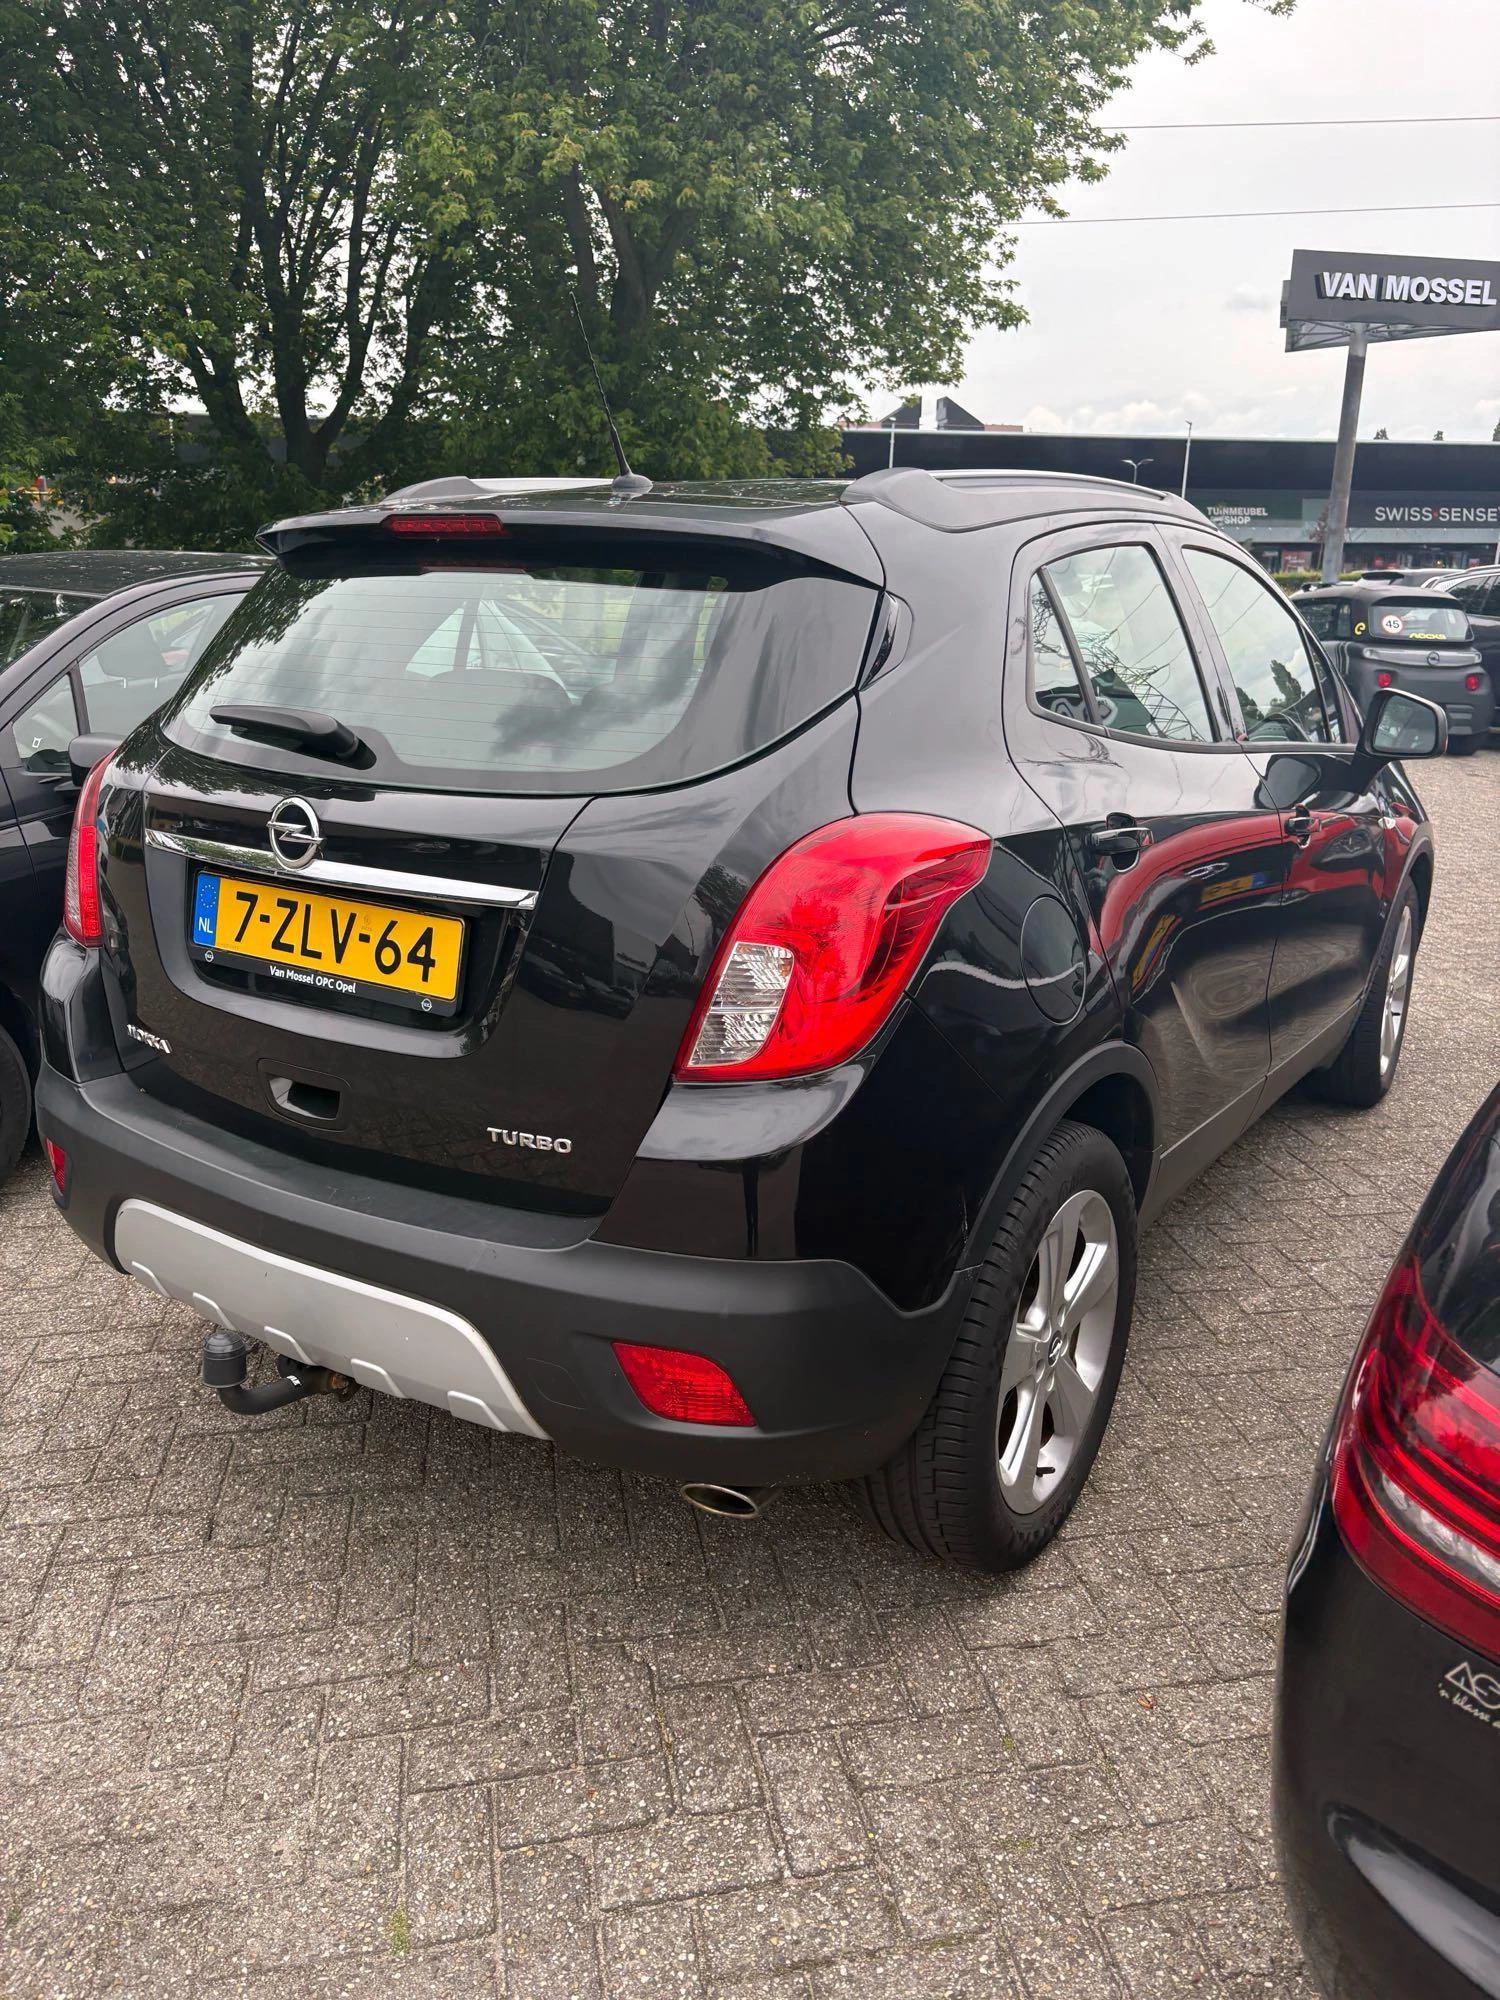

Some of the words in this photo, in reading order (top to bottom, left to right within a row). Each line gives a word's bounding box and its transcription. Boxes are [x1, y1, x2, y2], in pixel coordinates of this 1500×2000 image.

[1321, 271, 1378, 300] VAN
[1385, 275, 1497, 306] MOSSEL
[1224, 516, 1251, 525] SHOP
[1385, 619, 1400, 629] 45
[198, 916, 213, 934] NL
[234, 890, 436, 983] 7-ZLV-64
[269, 965, 285, 978] Van
[286, 969, 314, 984] Mossel
[315, 976, 335, 989] OPC
[335, 980, 356, 994] Opel
[486, 1126, 572, 1154] TURBO
